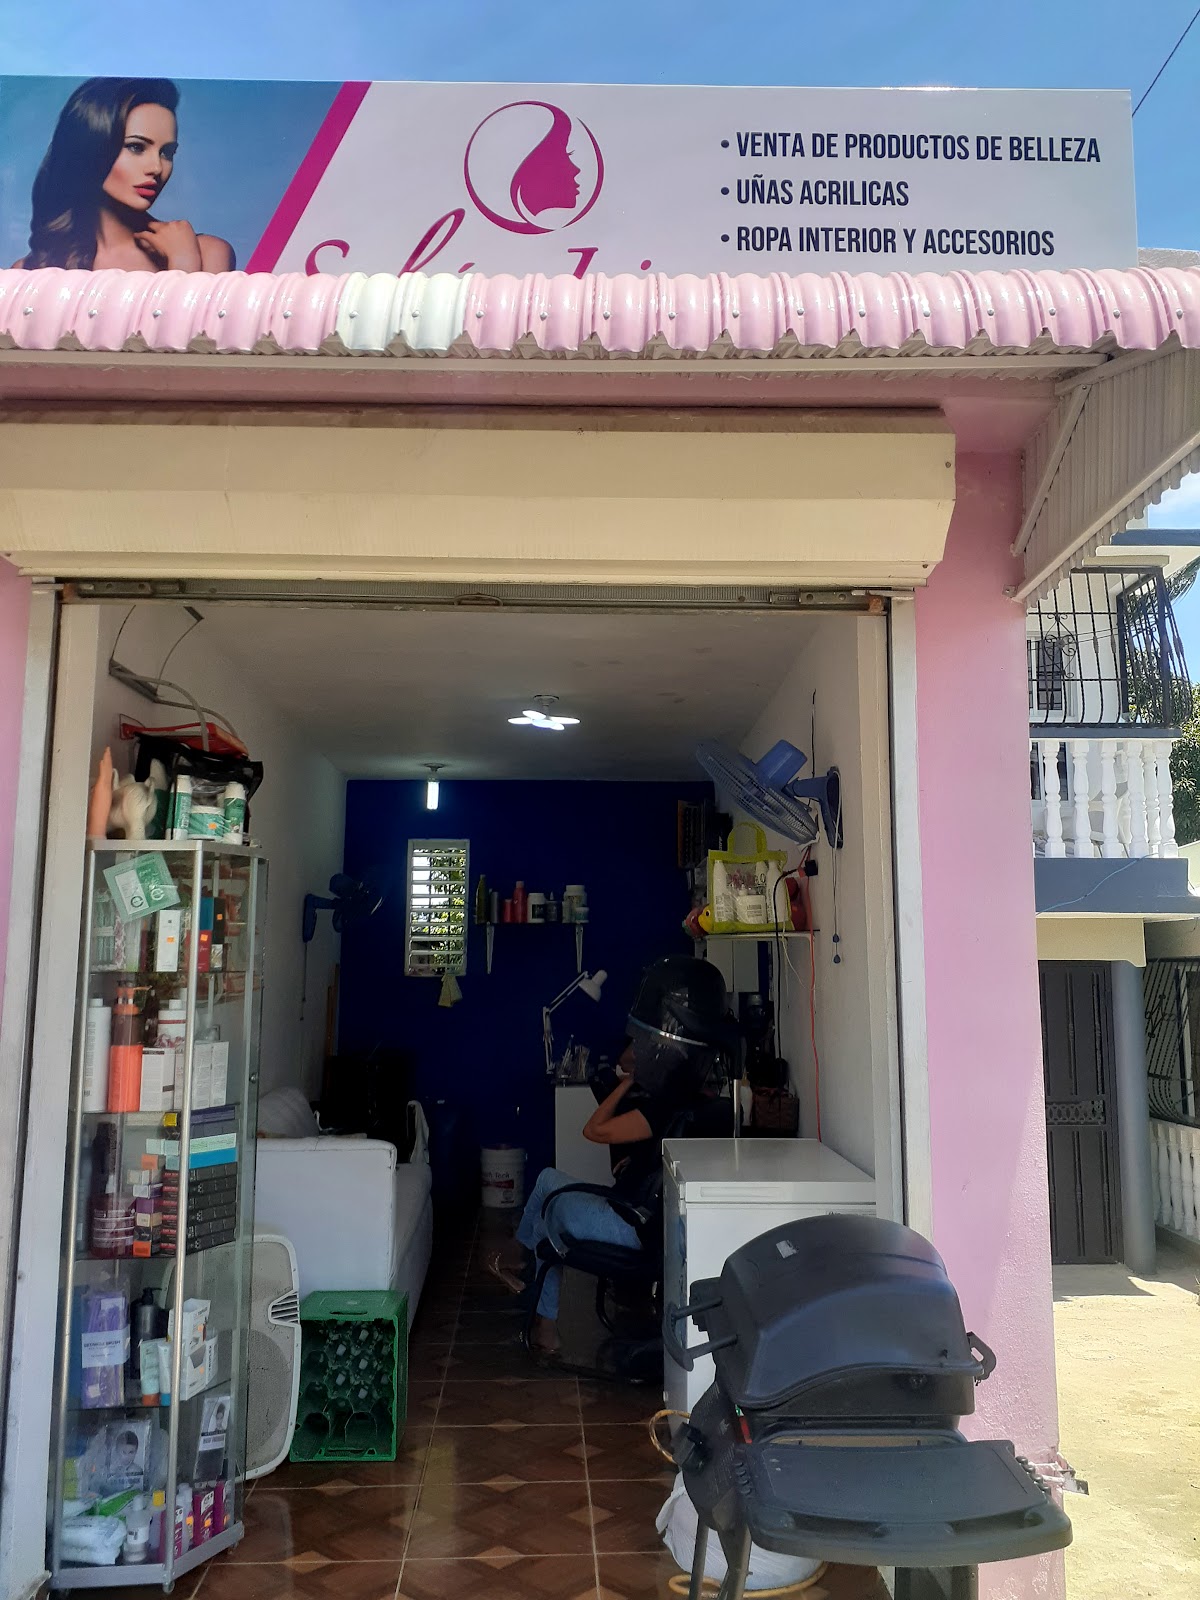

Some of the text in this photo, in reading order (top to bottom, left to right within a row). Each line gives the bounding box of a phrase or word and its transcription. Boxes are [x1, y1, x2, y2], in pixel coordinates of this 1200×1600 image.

[736, 131, 1101, 163] VENTA DE PRODUCTOS DE BELLEZA
[736, 173, 910, 206] UÑAS ACRILICAS
[737, 226, 1055, 256] ROPA INTERIOR Y ACCESORIOS
